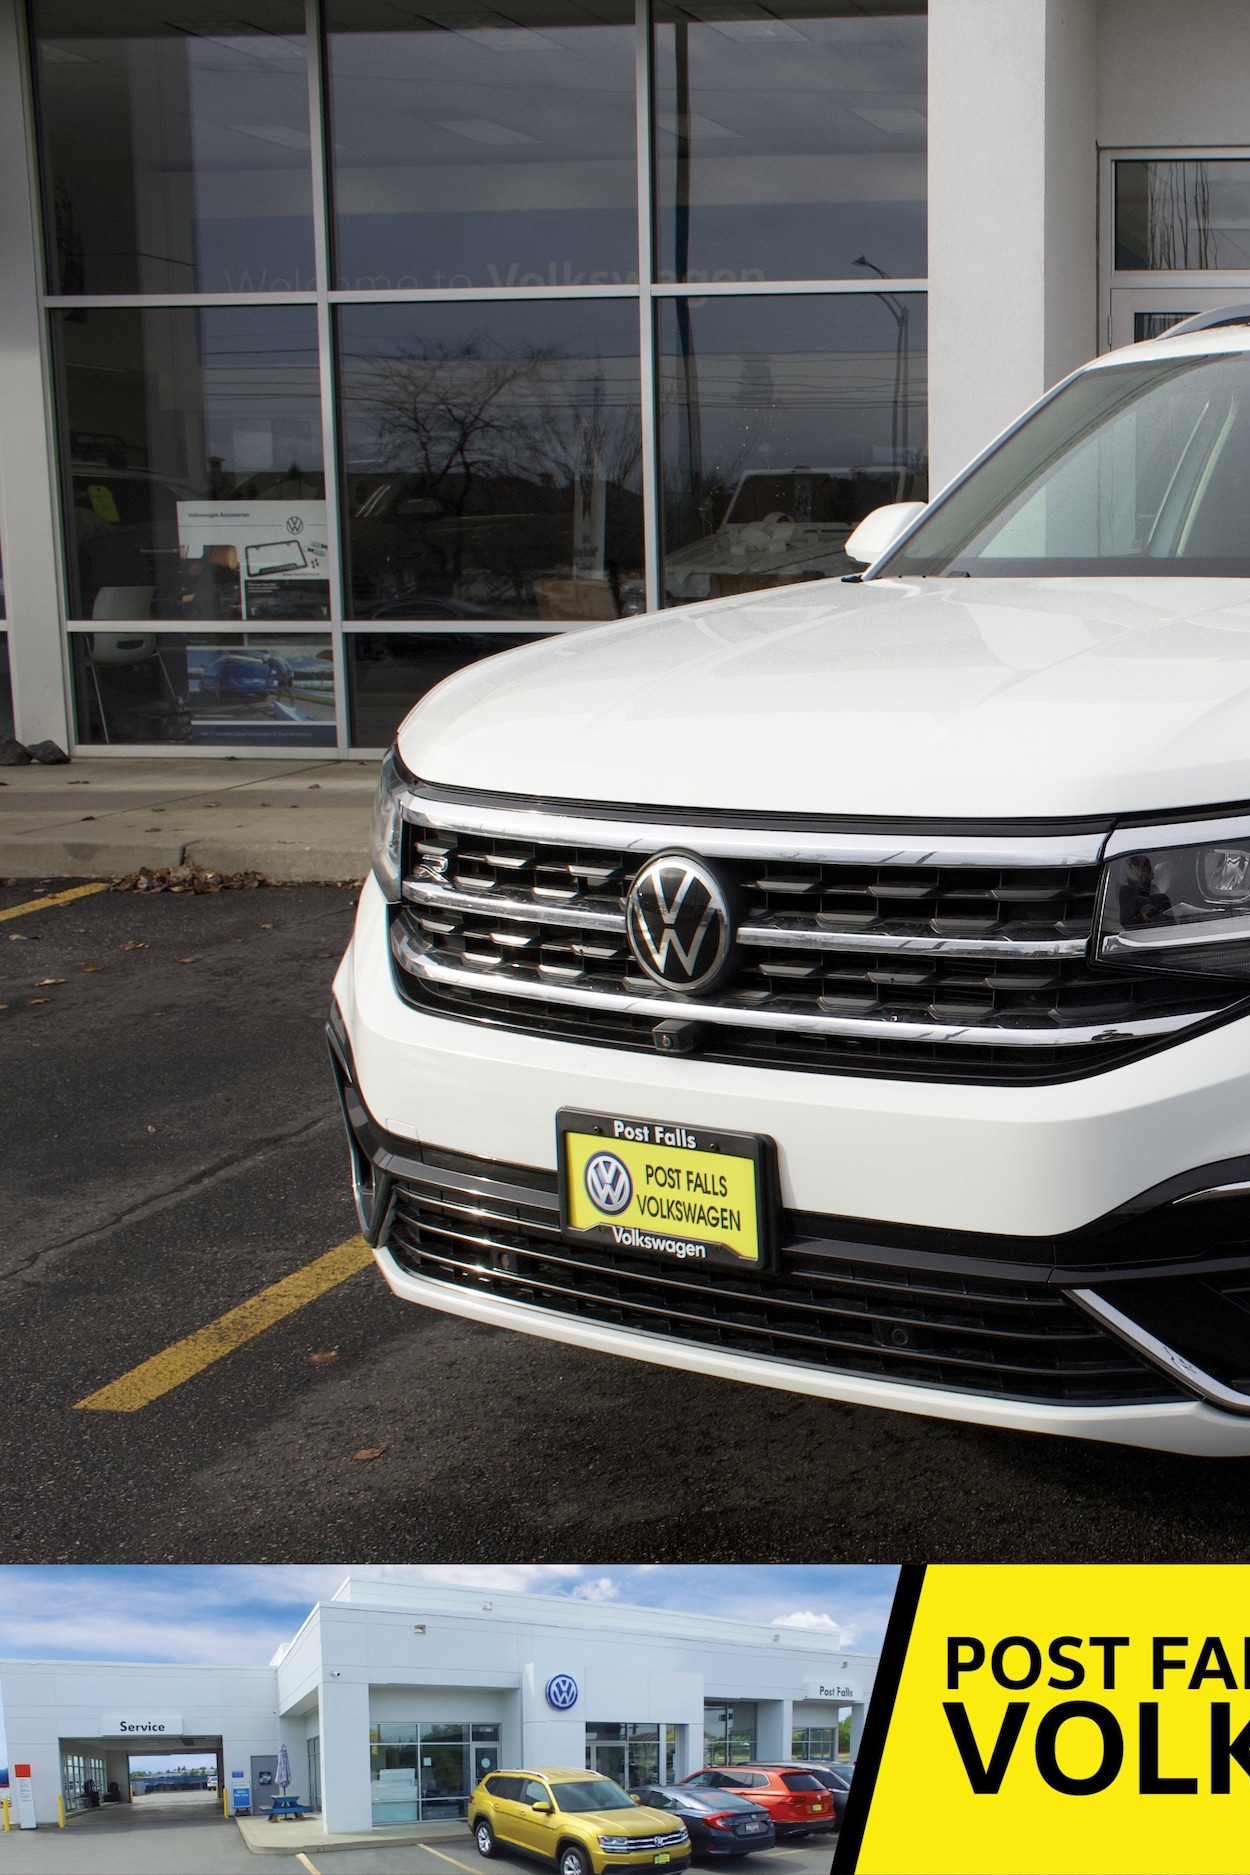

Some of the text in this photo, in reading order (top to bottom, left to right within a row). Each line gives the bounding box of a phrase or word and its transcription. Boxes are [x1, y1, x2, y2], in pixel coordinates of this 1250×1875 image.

[613, 1120, 697, 1149] Post Falls
[646, 1164, 728, 1197] POST FALLS
[636, 1194, 741, 1231] VOLKSWAGEN
[611, 1225, 707, 1259] Volkswagen
